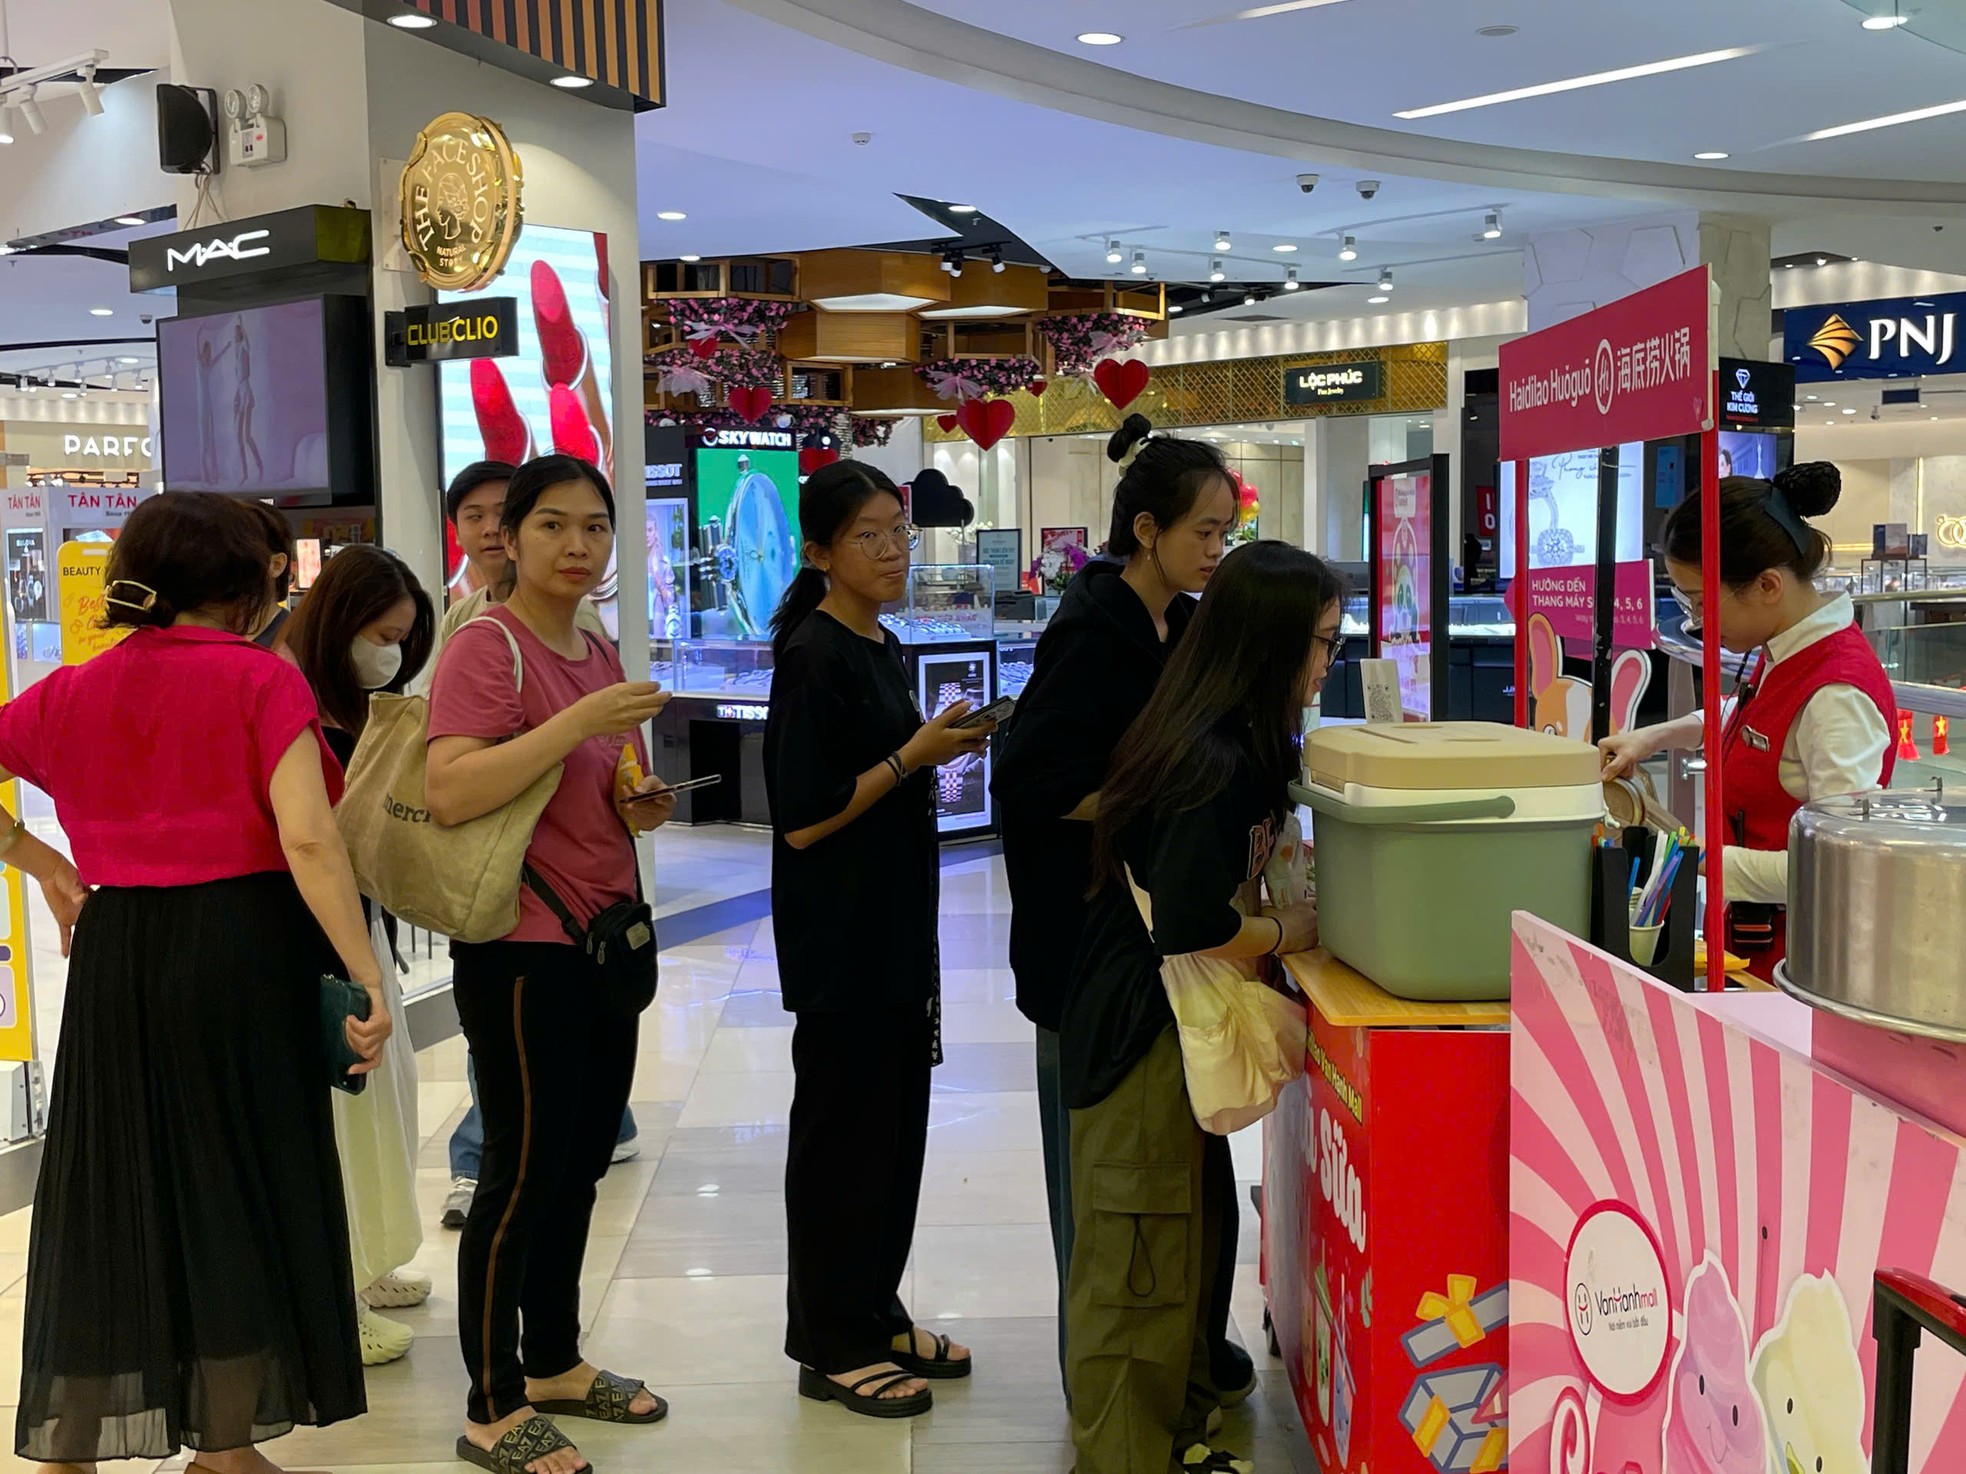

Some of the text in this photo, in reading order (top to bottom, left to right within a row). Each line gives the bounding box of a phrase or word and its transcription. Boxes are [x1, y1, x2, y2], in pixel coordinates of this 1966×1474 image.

[436, 245, 467, 256] NATURAL
[1868, 312, 1957, 365] PNJ
[1616, 326, 1691, 395] 海底捞火锅
[1299, 368, 1364, 391] LỘC PHÚC
[1730, 390, 1743, 402] THẾ
[645, 463, 683, 479] ISSOT
[8, 493, 41, 510] TÂN TÂN
[68, 491, 138, 509] TÂN TÂN
[62, 566, 101, 577] BEAUTY
[1566, 576, 1586, 593] ĐẾN
[1532, 594, 1565, 608] THANG
[1565, 593, 1585, 608] MÁY
[1586, 596, 1595, 609] S
[1636, 597, 1643, 610] 6
[1320, 1107, 1367, 1254] Sữa
